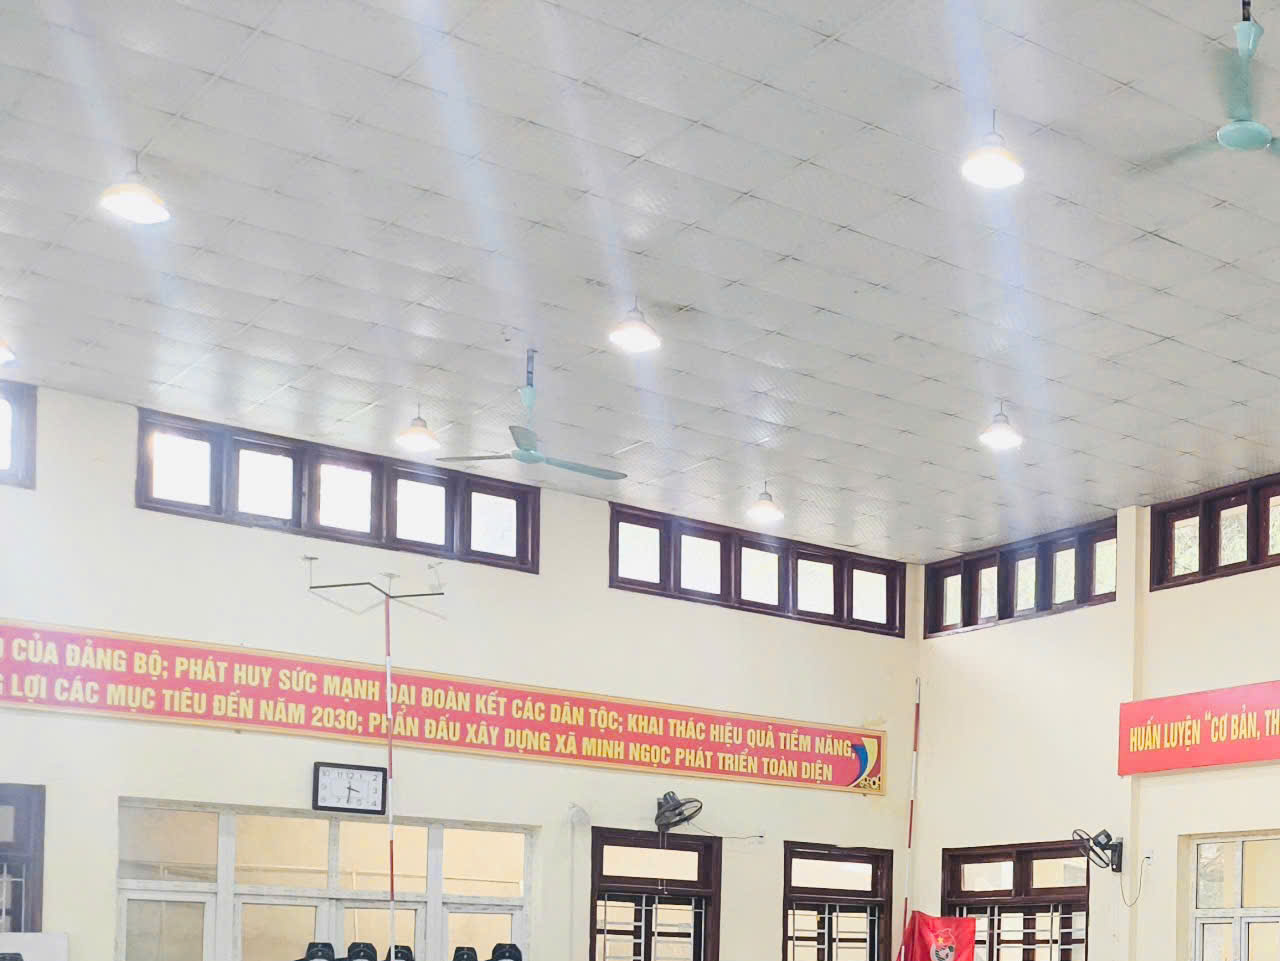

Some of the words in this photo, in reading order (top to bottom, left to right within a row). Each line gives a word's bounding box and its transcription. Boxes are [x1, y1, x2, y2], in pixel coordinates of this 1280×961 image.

[11, 673, 47, 703] LỢI
[54, 675, 99, 704] CÁC
[107, 683, 156, 712] MỤC
[162, 687, 207, 714] TIÊU
[212, 690, 254, 719] ĐẾN
[259, 697, 306, 725] NĂM
[311, 706, 363, 734] 2030;
[424, 714, 461, 742] ĐẤU
[465, 720, 500, 746] XÂY
[504, 727, 551, 753] DỰNG
[555, 732, 577, 755] XÃ
[582, 736, 625, 760] MINH
[629, 742, 671, 767] NGỌC
[674, 747, 713, 769] PHÁT
[716, 749, 758, 774] TRIỂN
[761, 755, 798, 778] TOÀN
[801, 760, 833, 784] DIỆN
[12, 632, 59, 665] CỦA
[66, 639, 127, 672] ĐẢNG
[133, 649, 169, 680] BỘ;
[175, 655, 228, 683] PHÁT
[234, 663, 273, 688] HUY
[278, 667, 318, 693] SỨC
[323, 674, 380, 702] MẠNH
[421, 686, 470, 712] ĐOÀN
[475, 689, 507, 716] KẾT
[511, 697, 546, 721] CÁC
[550, 702, 584, 726] DÂN
[588, 706, 623, 733] TỘC;
[627, 713, 664, 736] KHAI
[668, 717, 706, 740] THÁC
[710, 722, 743, 748] HIỆU
[747, 724, 775, 749] QUẢ
[1130, 715, 1160, 752] HUẤN
[1164, 715, 1201, 752] LUYỆN
[1230, 704, 1261, 741] BẢN,
